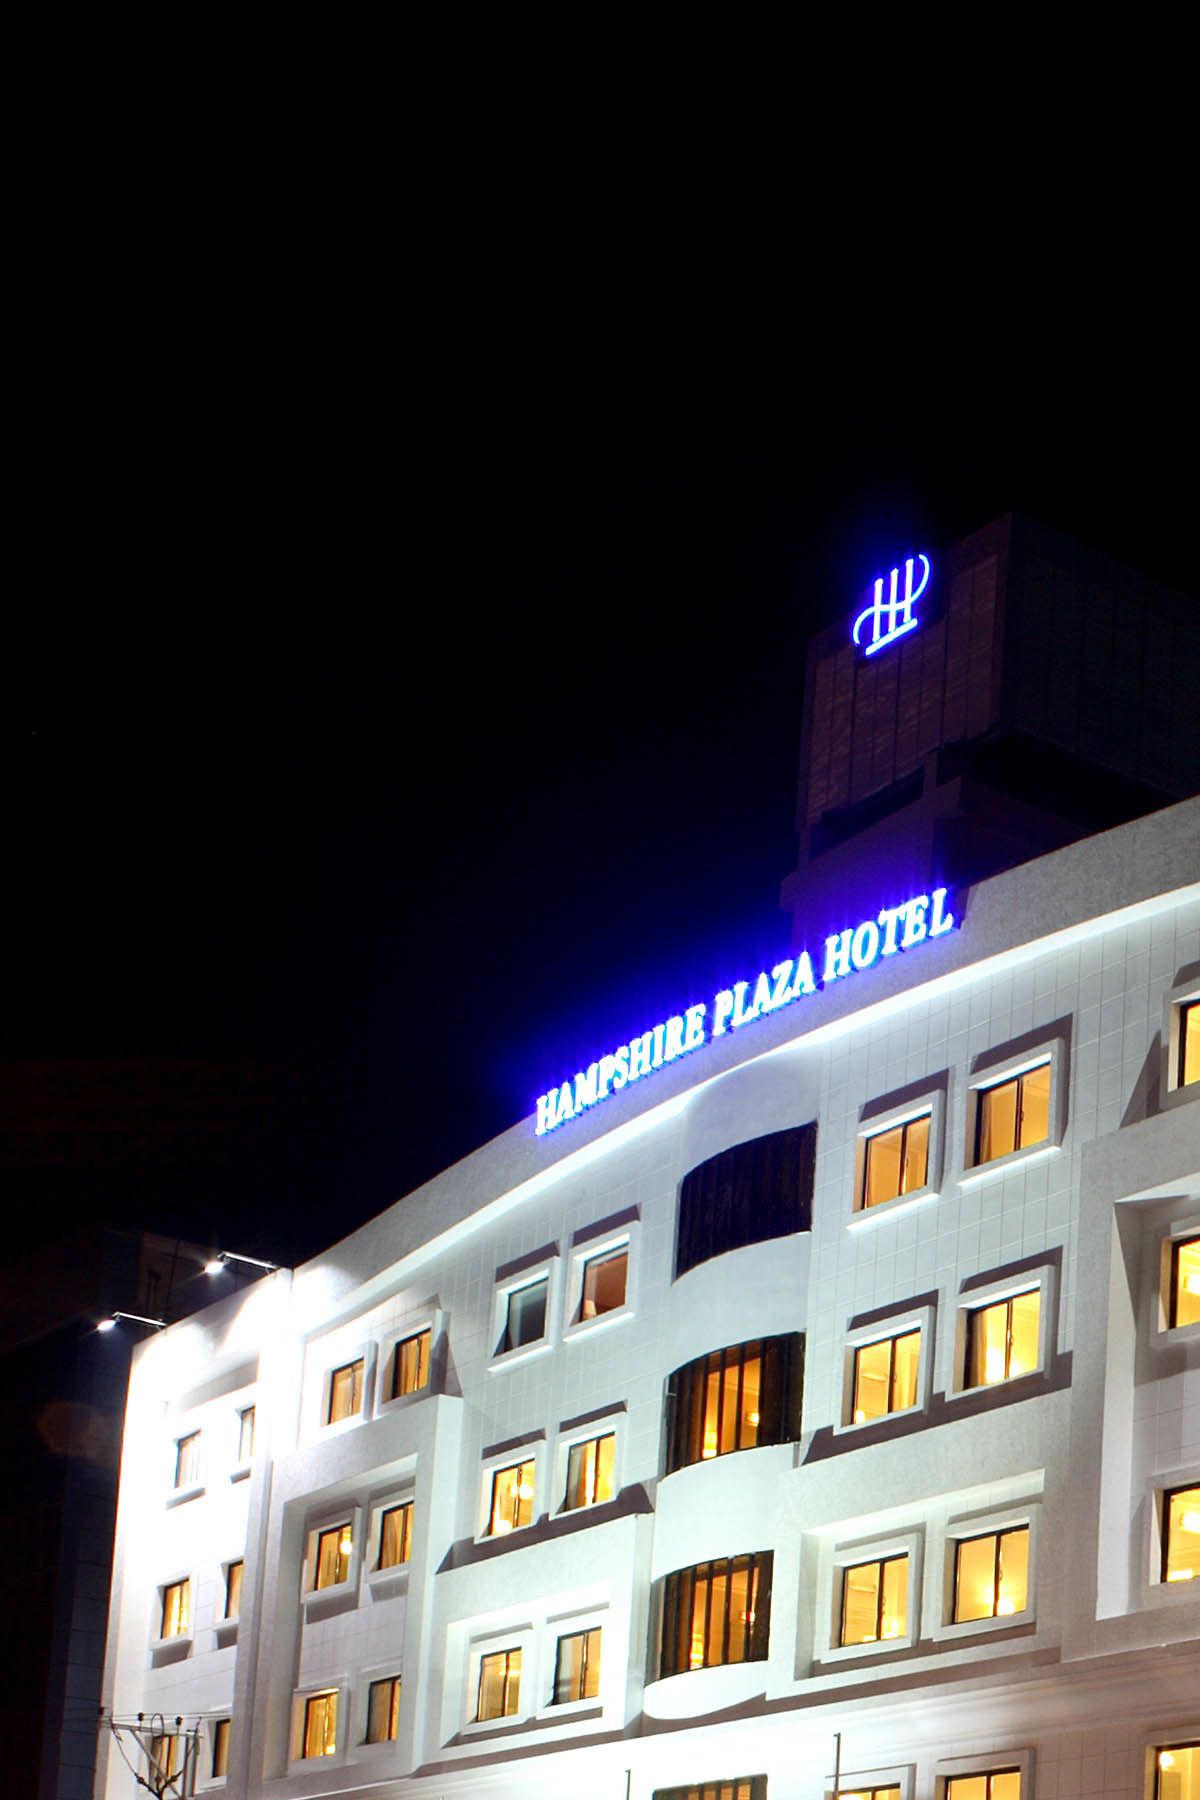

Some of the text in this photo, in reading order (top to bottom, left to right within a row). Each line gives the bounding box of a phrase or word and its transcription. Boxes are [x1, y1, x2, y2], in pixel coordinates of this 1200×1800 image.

[535, 888, 953, 1136] HAMPSHIRE PLAZA HOTEL
